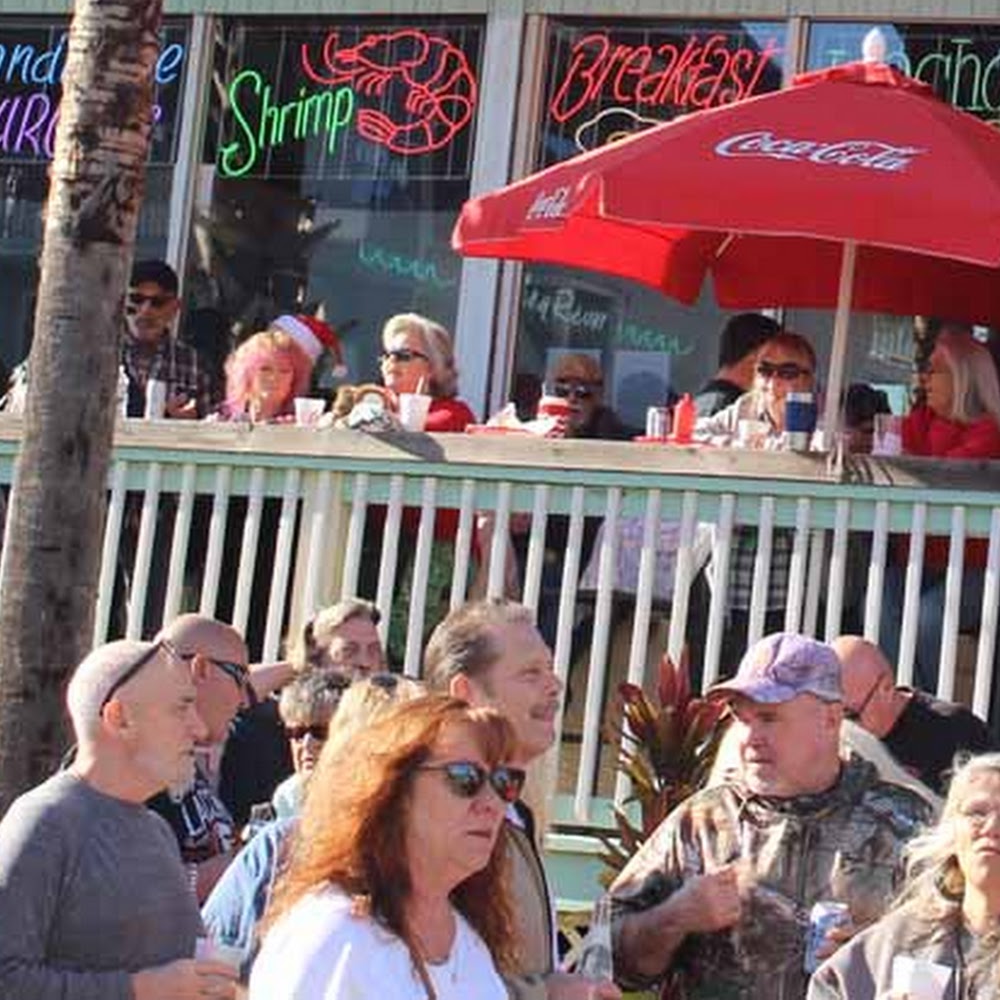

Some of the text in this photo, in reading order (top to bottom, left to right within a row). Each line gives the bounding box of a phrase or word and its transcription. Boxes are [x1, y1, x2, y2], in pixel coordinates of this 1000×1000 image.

[551, 33, 776, 122] Breakfast
[219, 68, 354, 178] Shrimp
[715, 130, 931, 172] Coca-Cola
